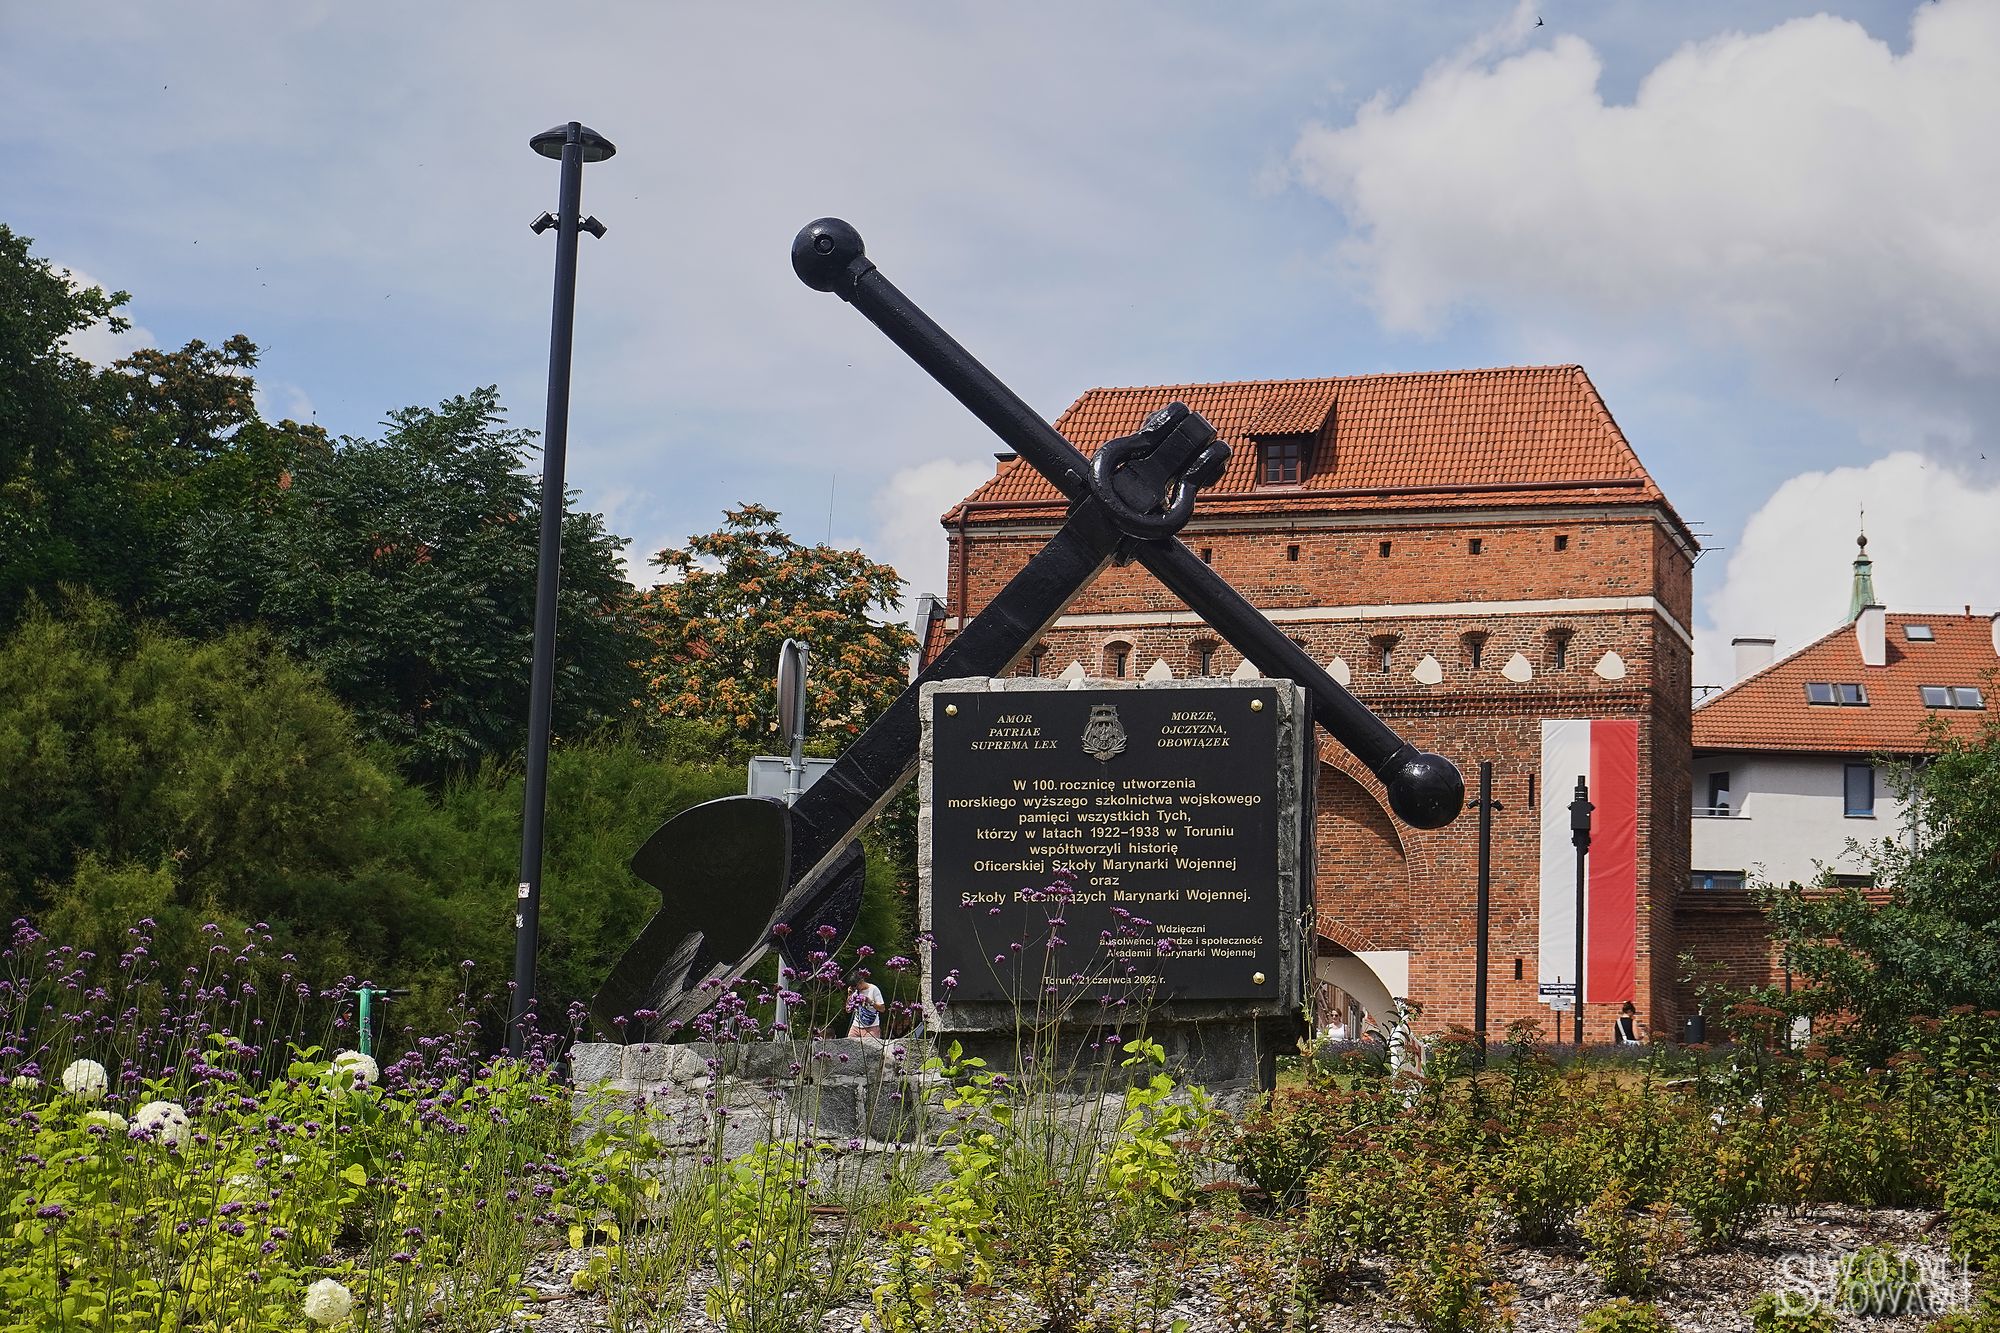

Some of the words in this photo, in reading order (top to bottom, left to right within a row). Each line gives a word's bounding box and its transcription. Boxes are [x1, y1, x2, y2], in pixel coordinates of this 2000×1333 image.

[997, 714, 1033, 724] AMOR
[1171, 711, 1217, 721] MORZE,
[988, 727, 1041, 737] PATRIAE
[1161, 724, 1227, 735] OJCZYZNA,
[970, 741, 1029, 751] SUPREMA
[1034, 740, 1058, 749] LEX
[1157, 737, 1230, 749] OBOWIĄZEK
[1013, 779, 1027, 791] W
[1032, 779, 1057, 791] 100.
[1060, 778, 1116, 792] rocznicę
[1122, 777, 1196, 790] utworzenia
[948, 796, 1017, 810] morskiego
[1023, 795, 1088, 809] wyższego
[1095, 794, 1173, 806] szkolnictwa
[1179, 793, 1262, 807] wojskowego
[1018, 811, 1070, 825] pamięci
[1077, 810, 1150, 825] wszystkich
[1156, 809, 1191, 823] Tych,
[976, 828, 1018, 842] którzy
[1025, 830, 1036, 839] w
[1042, 827, 1083, 839] latach
[1165, 827, 1177, 837] w
[1184, 825, 1234, 837] Toruniu
[1029, 842, 1121, 857] współtworzyli
[1128, 842, 1178, 855] historię
[973, 860, 1045, 874] Oficerskiej
[1052, 859, 1096, 873] Szkoły
[1103, 858, 1169, 873] Marynarki
[1175, 857, 1237, 871] Wojennej
[1090, 876, 1120, 886] oraz
[961, 891, 1006, 905] Szkoły
[1014, 889, 1106, 905] Pchoążych
[1114, 889, 1179, 904] Marynarki
[1186, 888, 1251, 902] Wojennej.
[1156, 924, 1206, 935] Wdzięczni
[1100, 937, 1157, 947] asolwenci,
[1201, 935, 1263, 947] społeczność
[1211, 947, 1256, 958] Wojennej
[1079, 975, 1090, 985] 21
[1092, 976, 1132, 985] czerwca
[1134, 975, 1157, 985] 2022
[1160, 976, 1166, 984] r.
